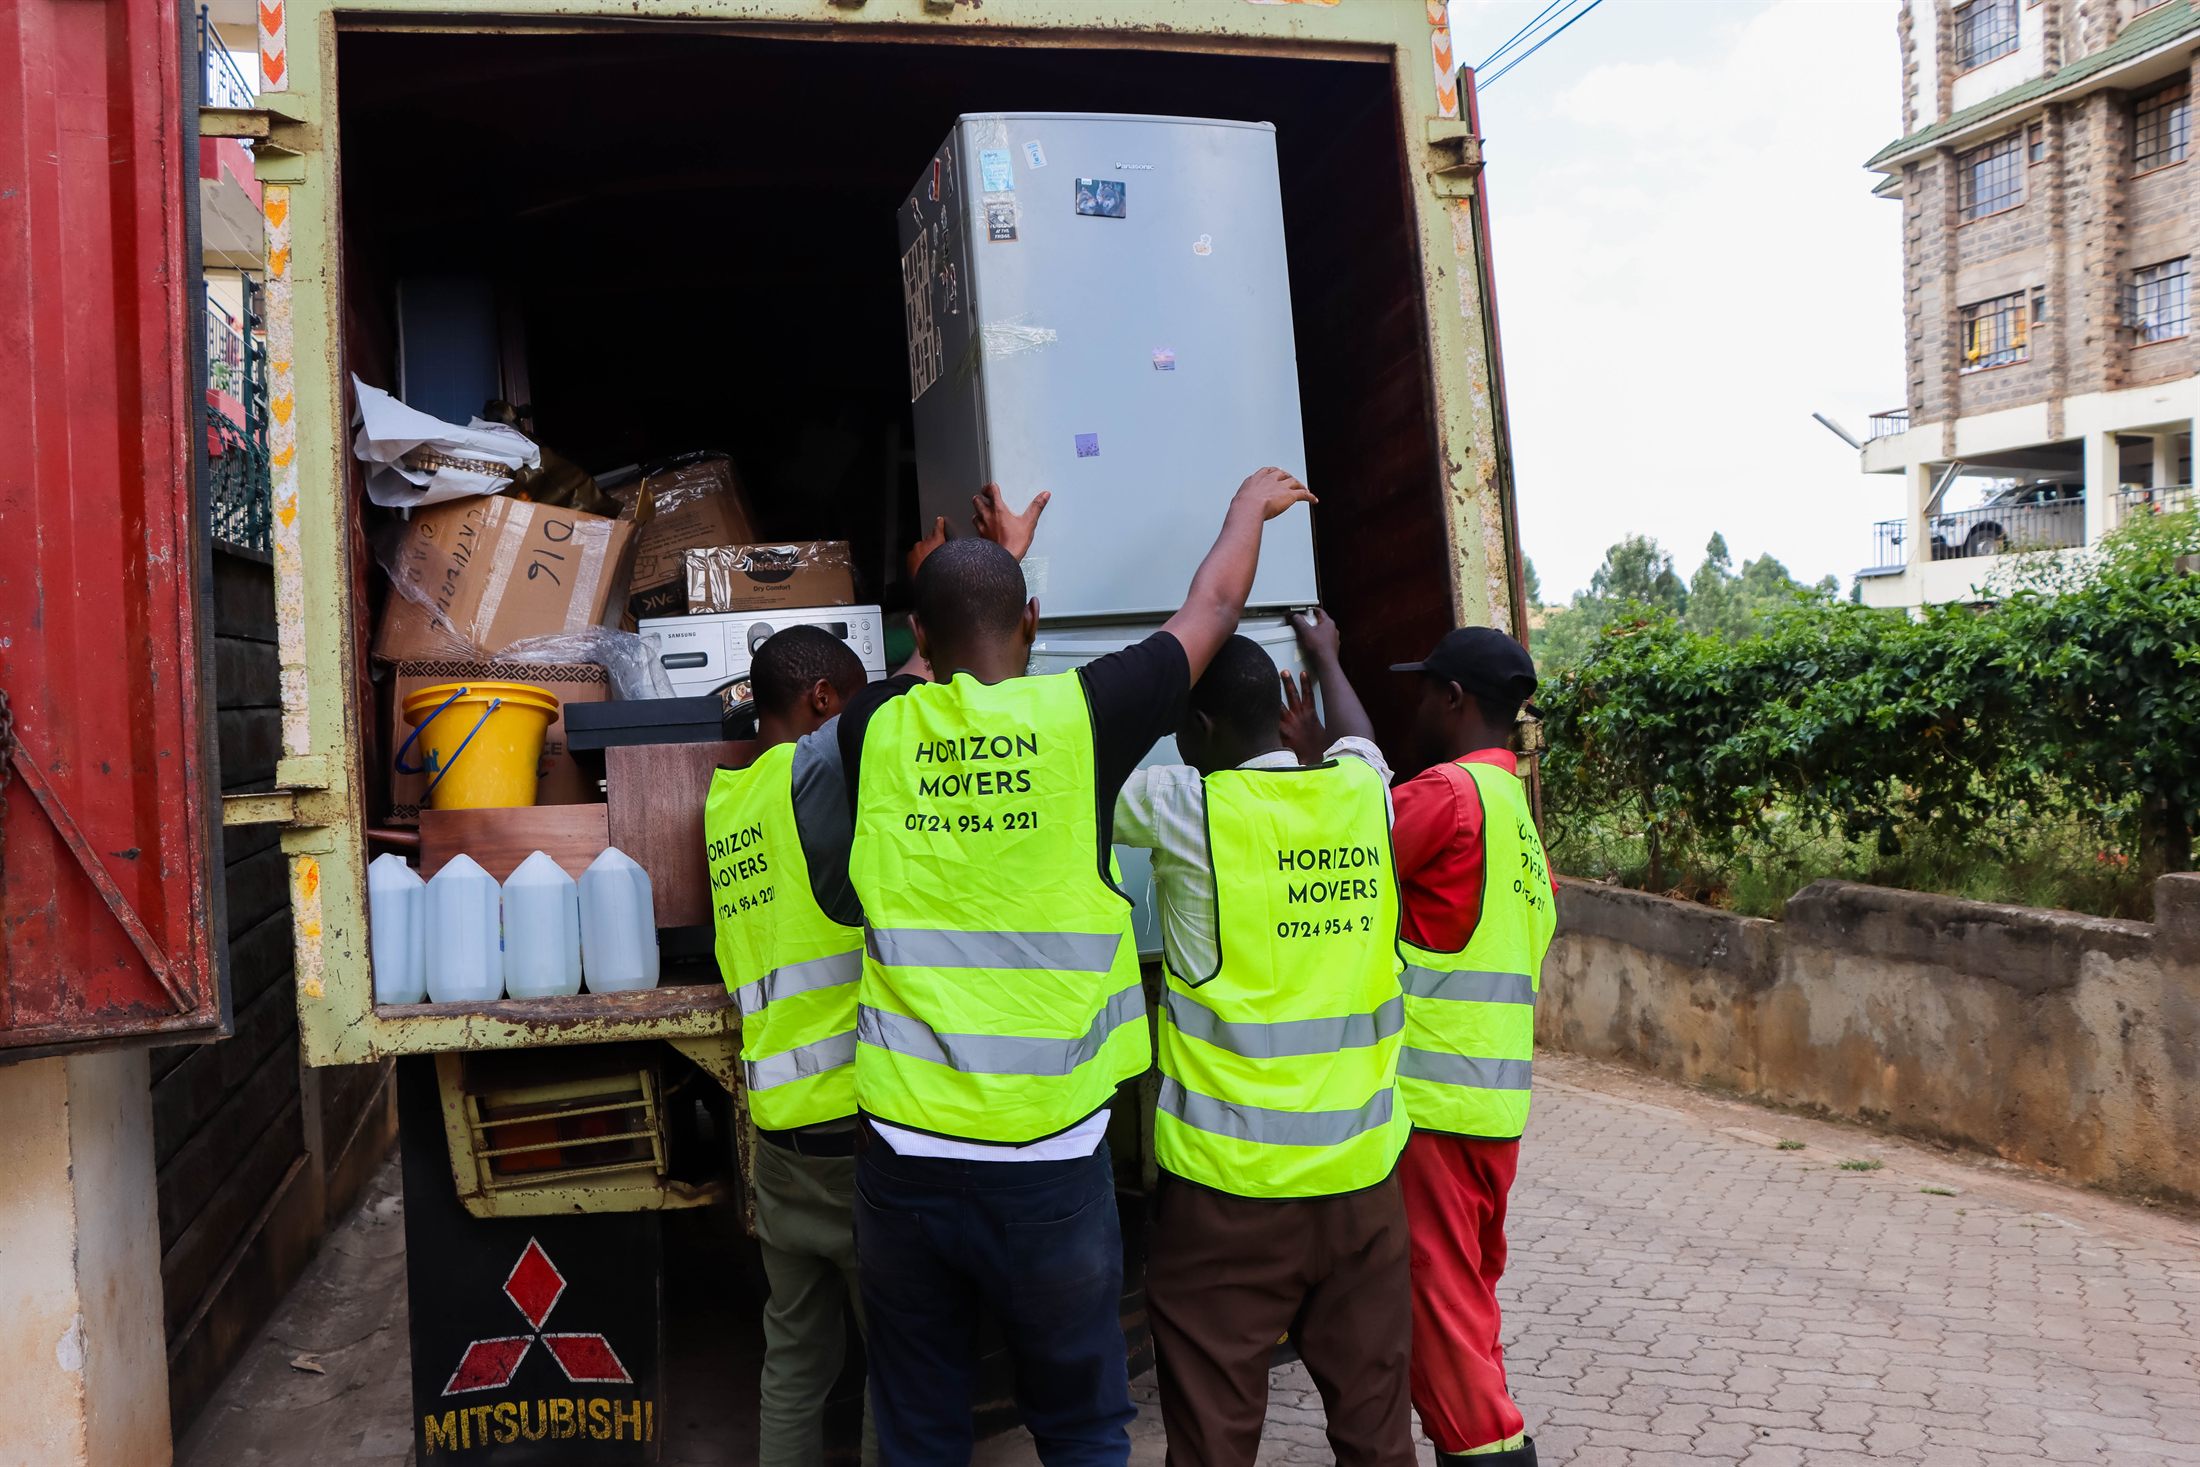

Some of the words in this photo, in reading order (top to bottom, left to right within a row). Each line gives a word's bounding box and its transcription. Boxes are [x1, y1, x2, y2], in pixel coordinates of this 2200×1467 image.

[1115, 161, 1155, 170] Panasonic
[668, 631, 697, 639] SAMSUNG
[915, 733, 1038, 763] HORIZON
[919, 769, 1031, 797] MOVERS
[905, 813, 951, 833] 0724
[958, 814, 994, 833] 954
[1003, 811, 1038, 830] 221
[706, 822, 764, 862] ORIZON
[1278, 847, 1380, 871] HORIZON
[739, 894, 758, 911] 954
[1288, 878, 1378, 904] MOVERS
[1277, 921, 1320, 938] 0724
[1325, 918, 1353, 935] 954
[424, 1398, 654, 1456] MITSUBISHI
